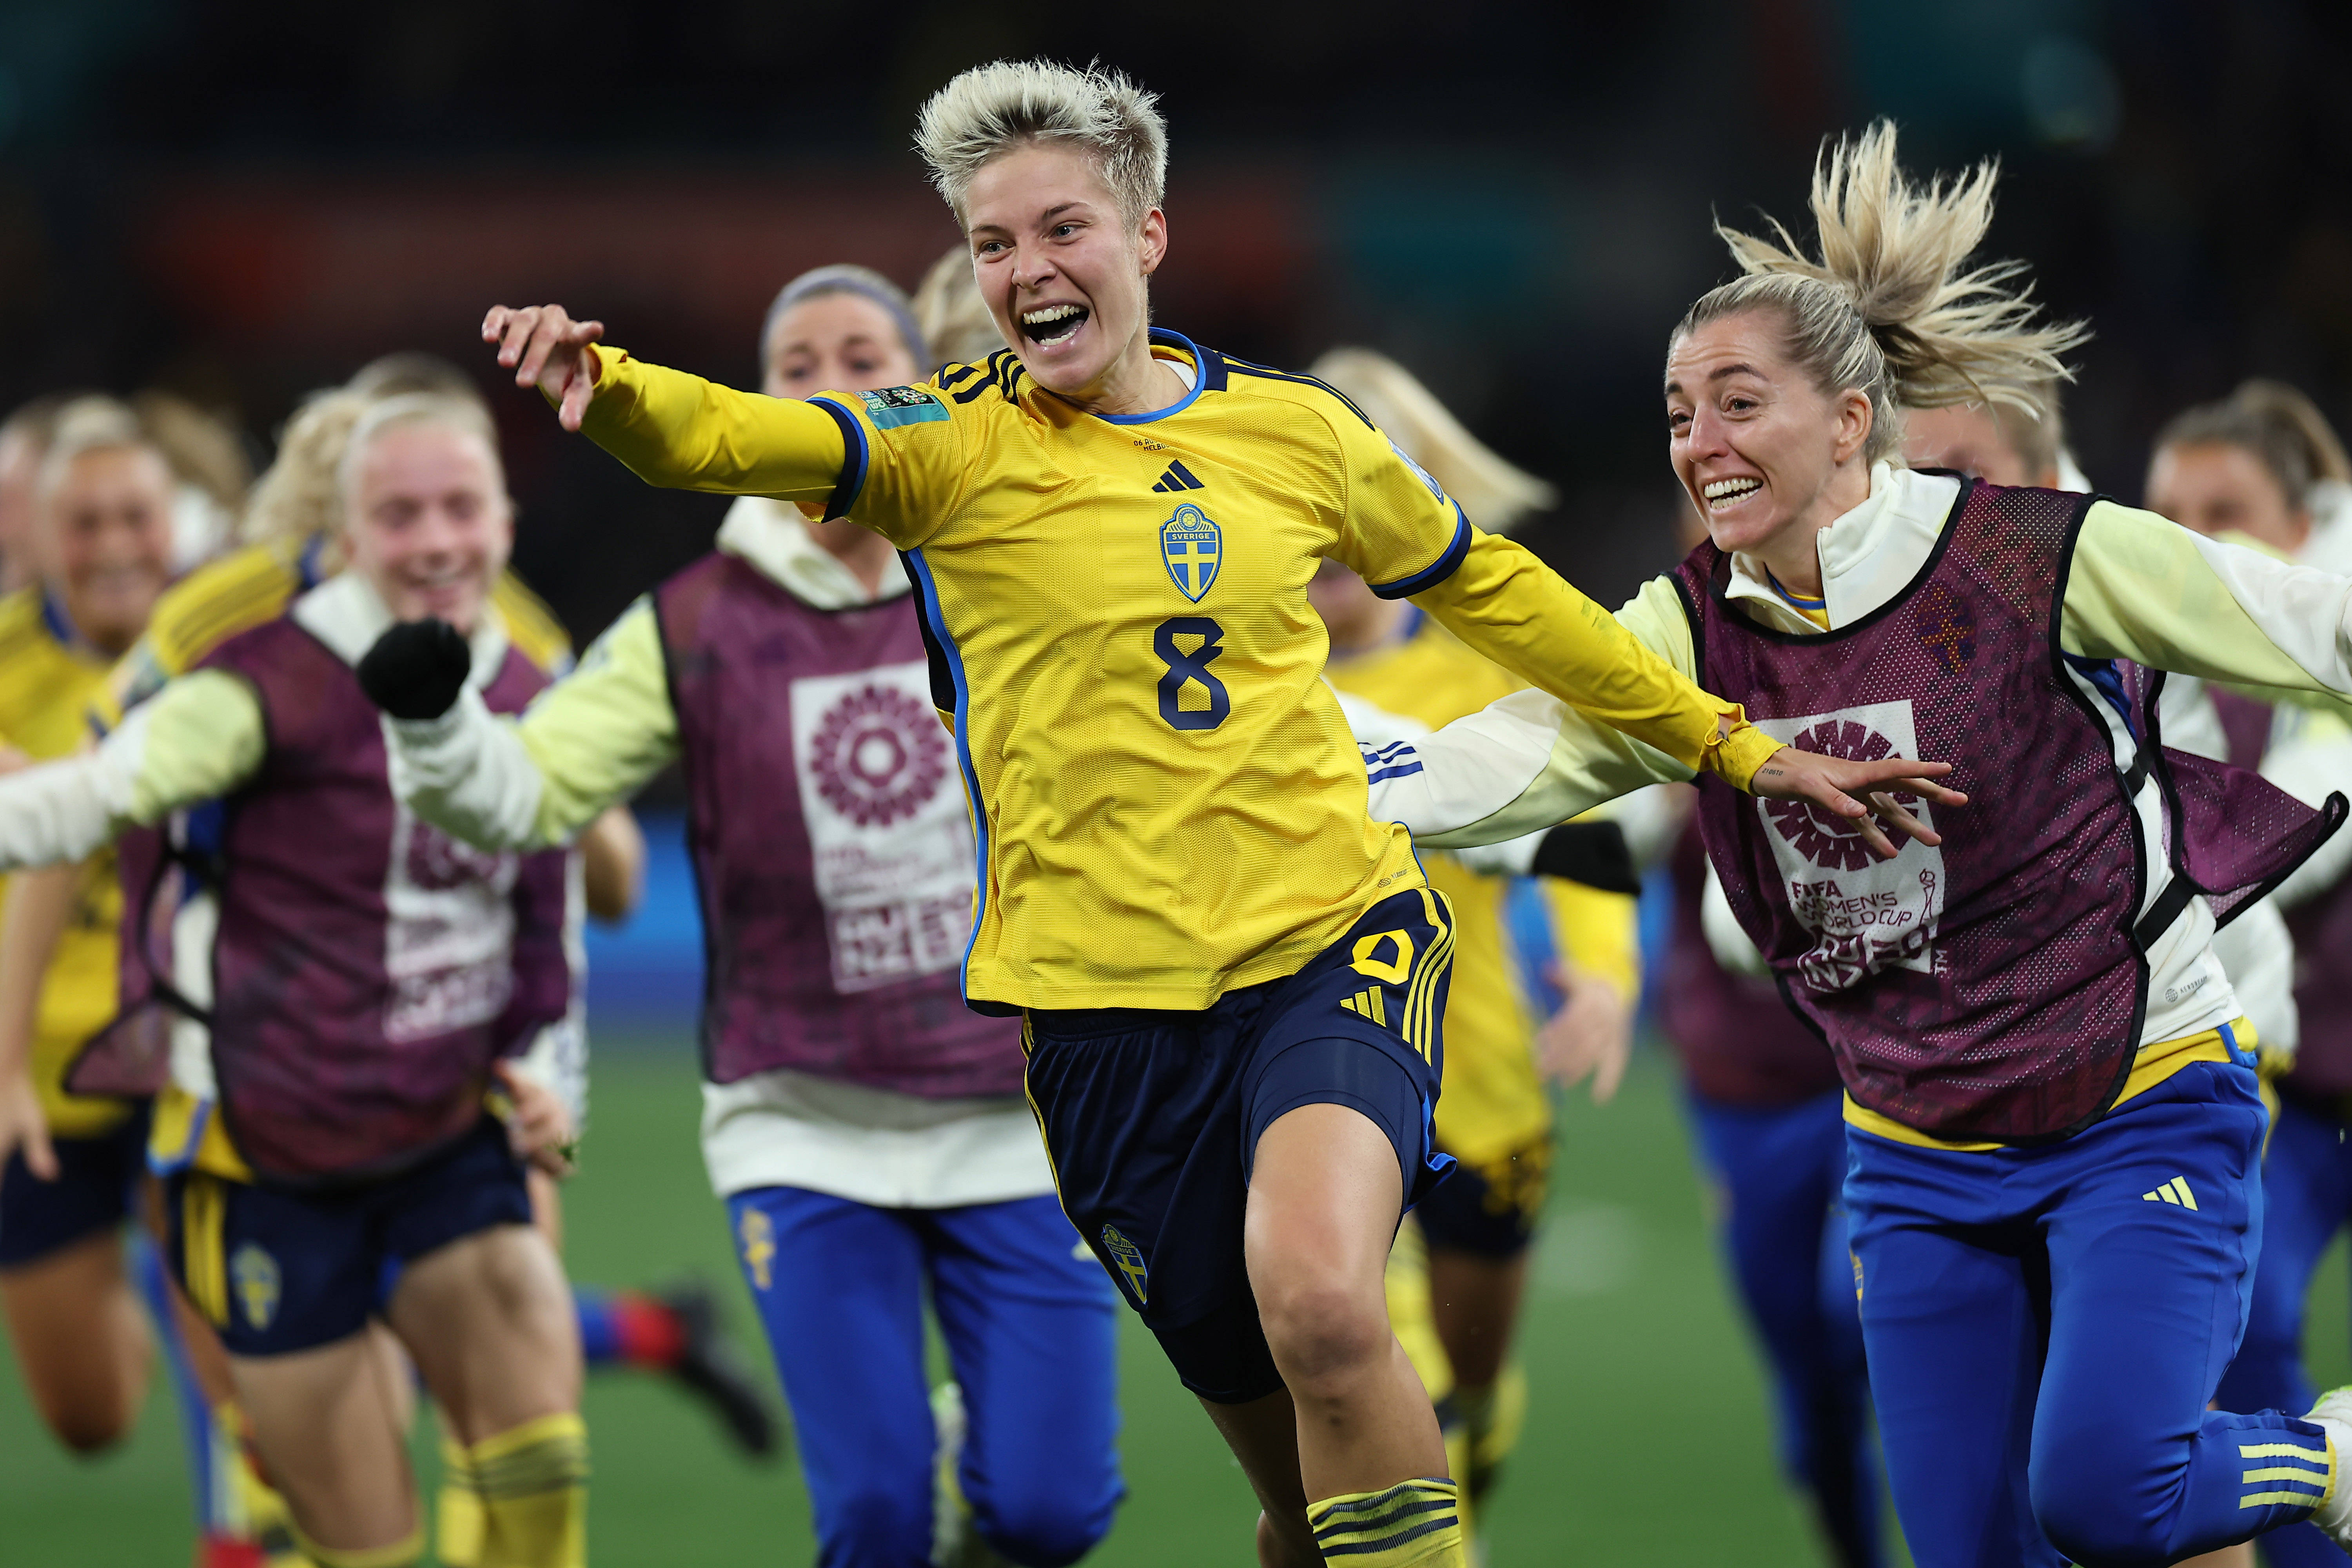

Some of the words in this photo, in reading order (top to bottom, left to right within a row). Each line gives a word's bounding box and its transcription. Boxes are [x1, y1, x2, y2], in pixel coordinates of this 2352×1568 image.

[1152, 616, 1230, 730] 8
[1791, 880, 1842, 898] FIFA
[1797, 891, 1897, 914] WOMEN'S
[1804, 910, 1876, 929] WORLD
[1879, 909, 1912, 927] CUP
[1934, 949, 1948, 977] TM
